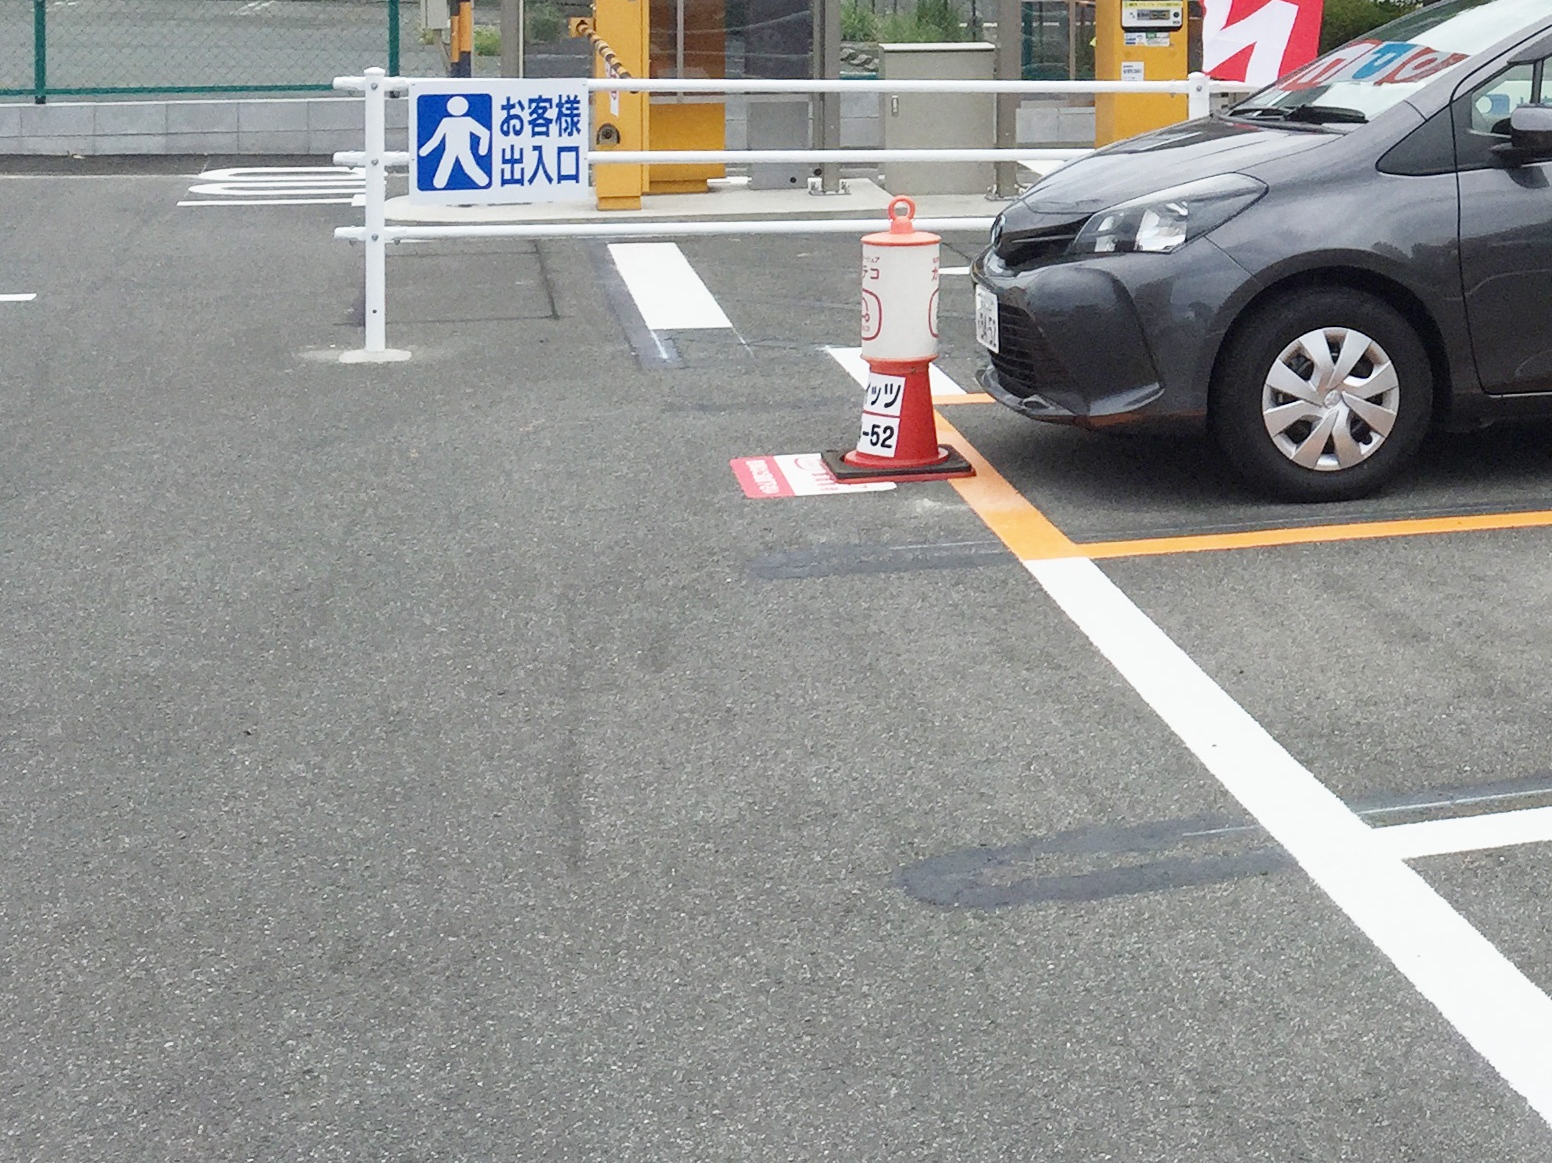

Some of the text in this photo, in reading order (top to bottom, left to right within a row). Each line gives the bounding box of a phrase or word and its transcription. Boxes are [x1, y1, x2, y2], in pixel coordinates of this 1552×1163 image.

[500, 94, 581, 137] お客様
[500, 144, 580, 187] 出入口
